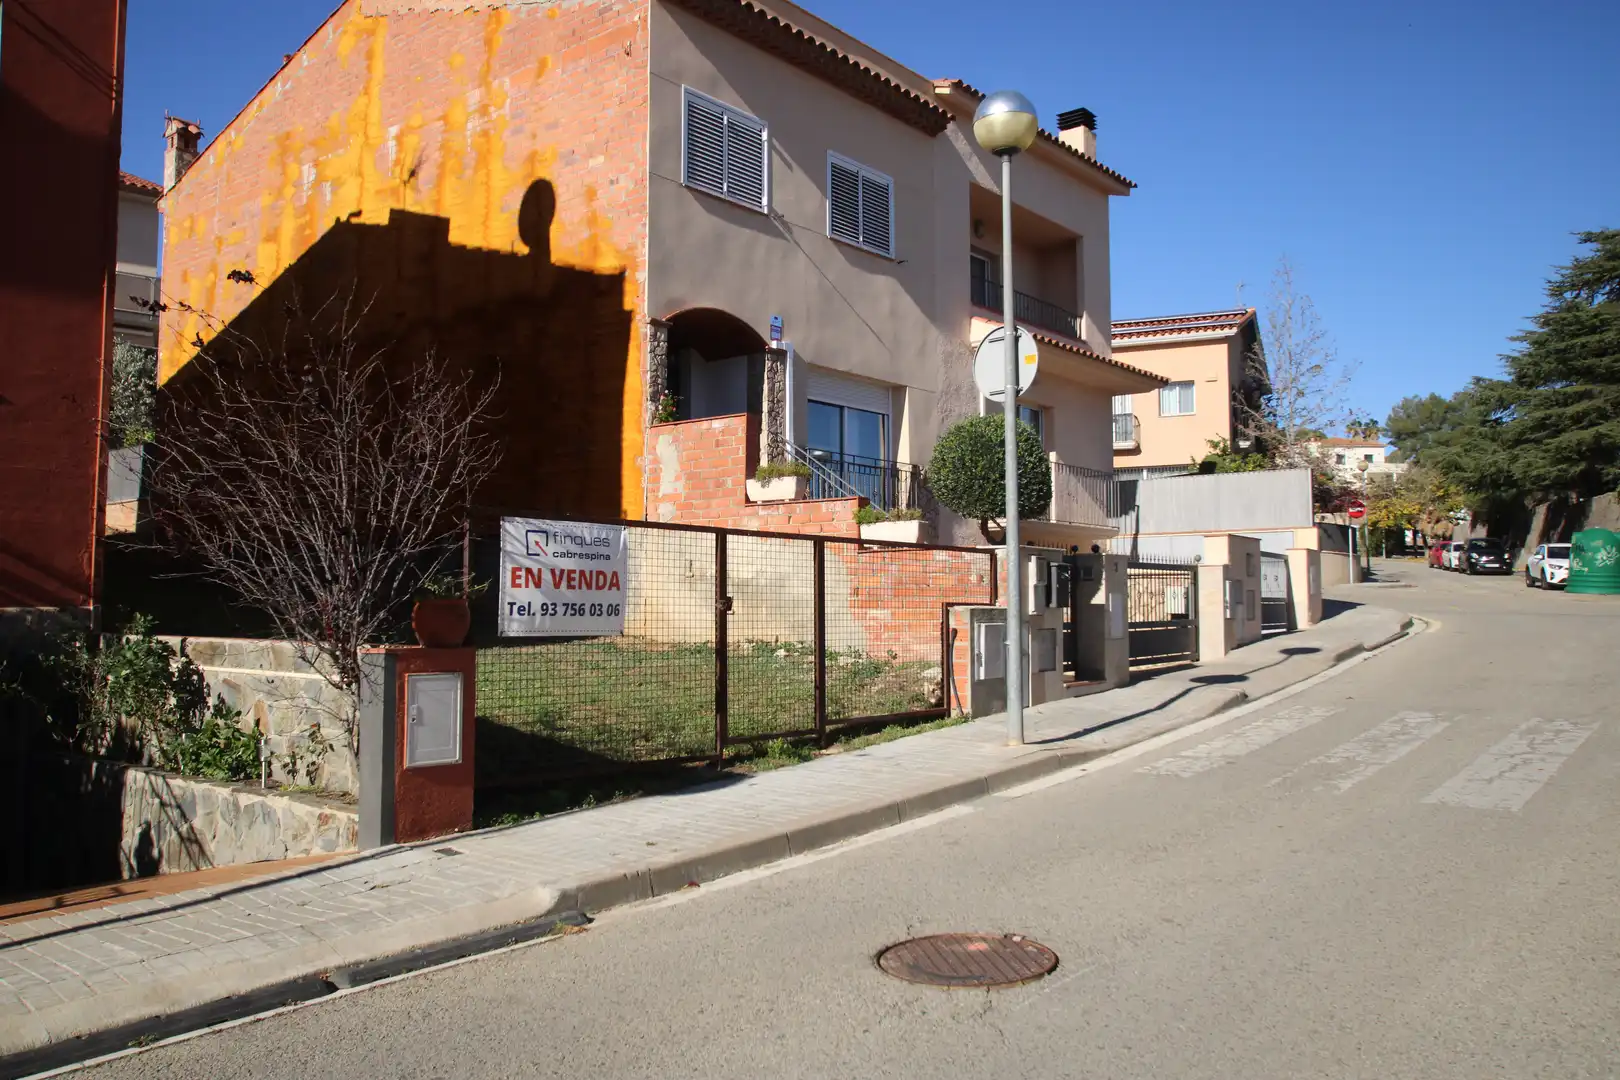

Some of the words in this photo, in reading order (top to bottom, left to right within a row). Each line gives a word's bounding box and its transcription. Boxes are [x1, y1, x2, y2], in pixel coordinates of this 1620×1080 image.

[553, 532, 610, 548] finques
[552, 550, 611, 561] cabrespina
[510, 566, 542, 588] EN
[550, 568, 621, 591] VENDA
[507, 601, 536, 616] Tel.
[540, 602, 558, 616] 93
[562, 603, 586, 617] 756
[589, 603, 603, 617] 03
[606, 603, 620, 617] 06
